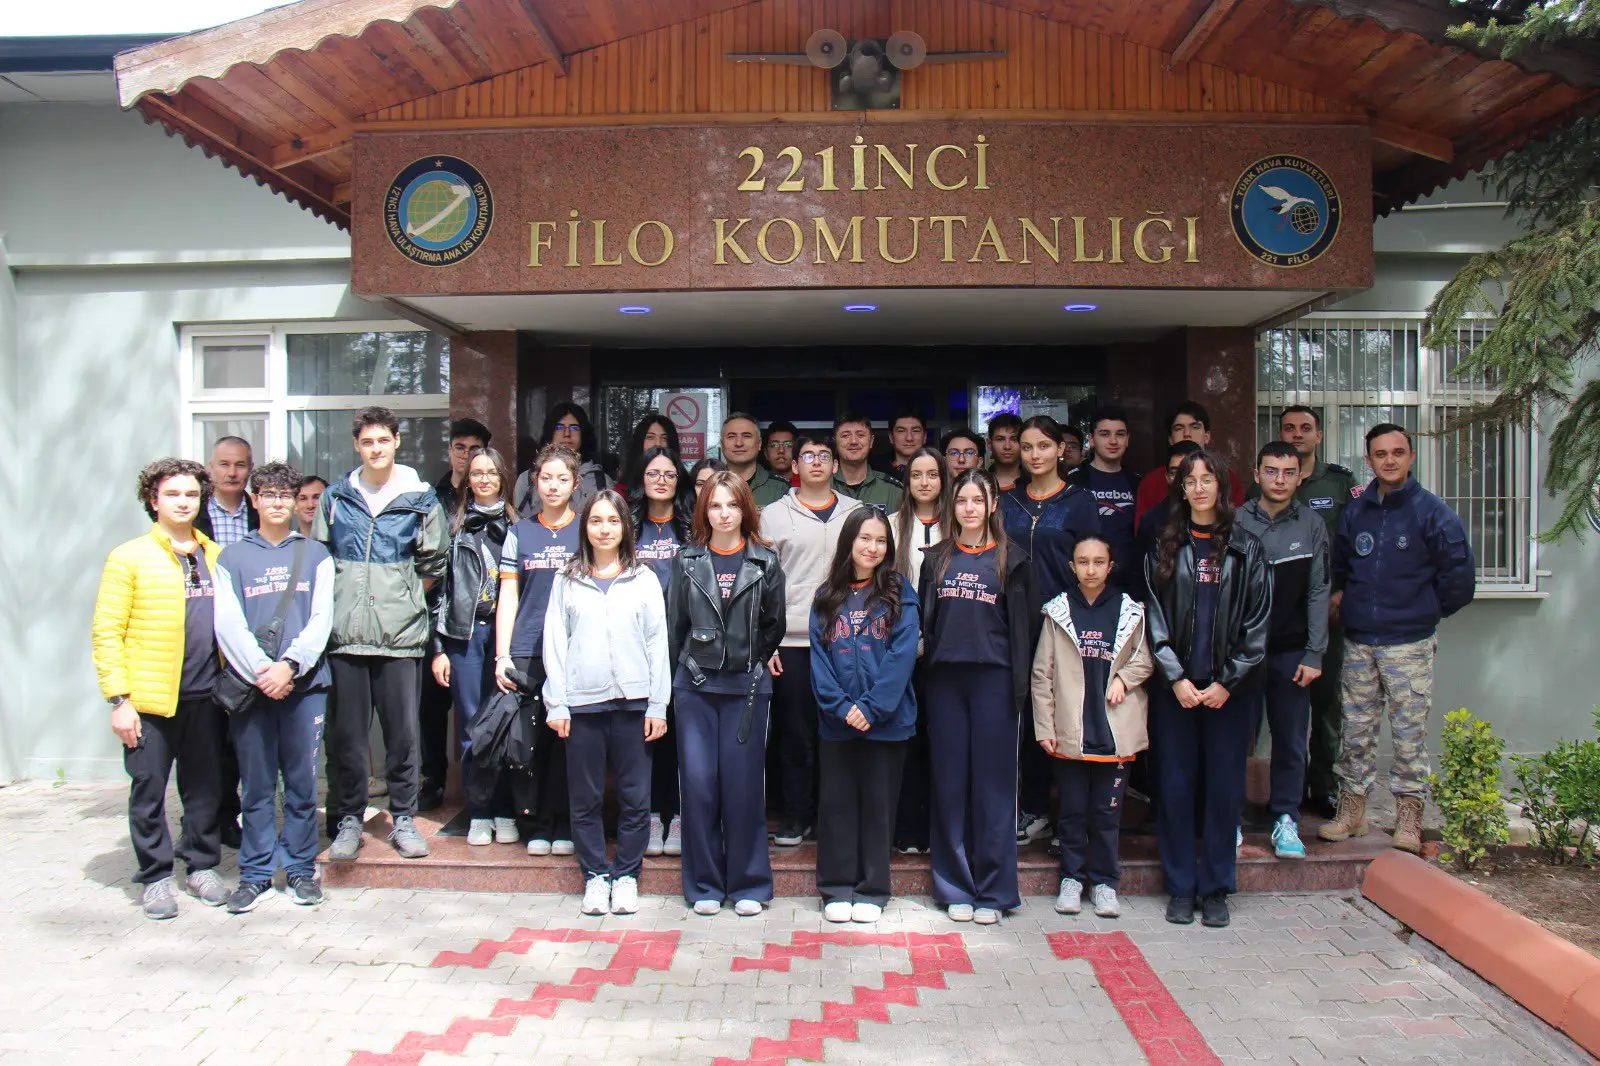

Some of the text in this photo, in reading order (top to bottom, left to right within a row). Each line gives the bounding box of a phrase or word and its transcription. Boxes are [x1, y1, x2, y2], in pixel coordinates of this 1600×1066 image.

[736, 134, 991, 193] 221İNCİ
[1236, 158, 1337, 200] TÜRK HAVA KUVVETLERİ
[387, 214, 400, 237] HAVA
[396, 235, 442, 262] ULAŞTIRMA
[443, 249, 462, 261] ANA
[460, 240, 474, 252] ÜS
[470, 182, 488, 243] KOMUTANLIĞI
[526, 209, 1201, 268] FİLO KOMUTANLIĞI
[1260, 251, 1310, 265] 221 FİLO
[954, 572, 979, 582] 1893
[958, 580, 988, 590] MEKTEP
[1084, 639, 1111, 648] MEKTEP
